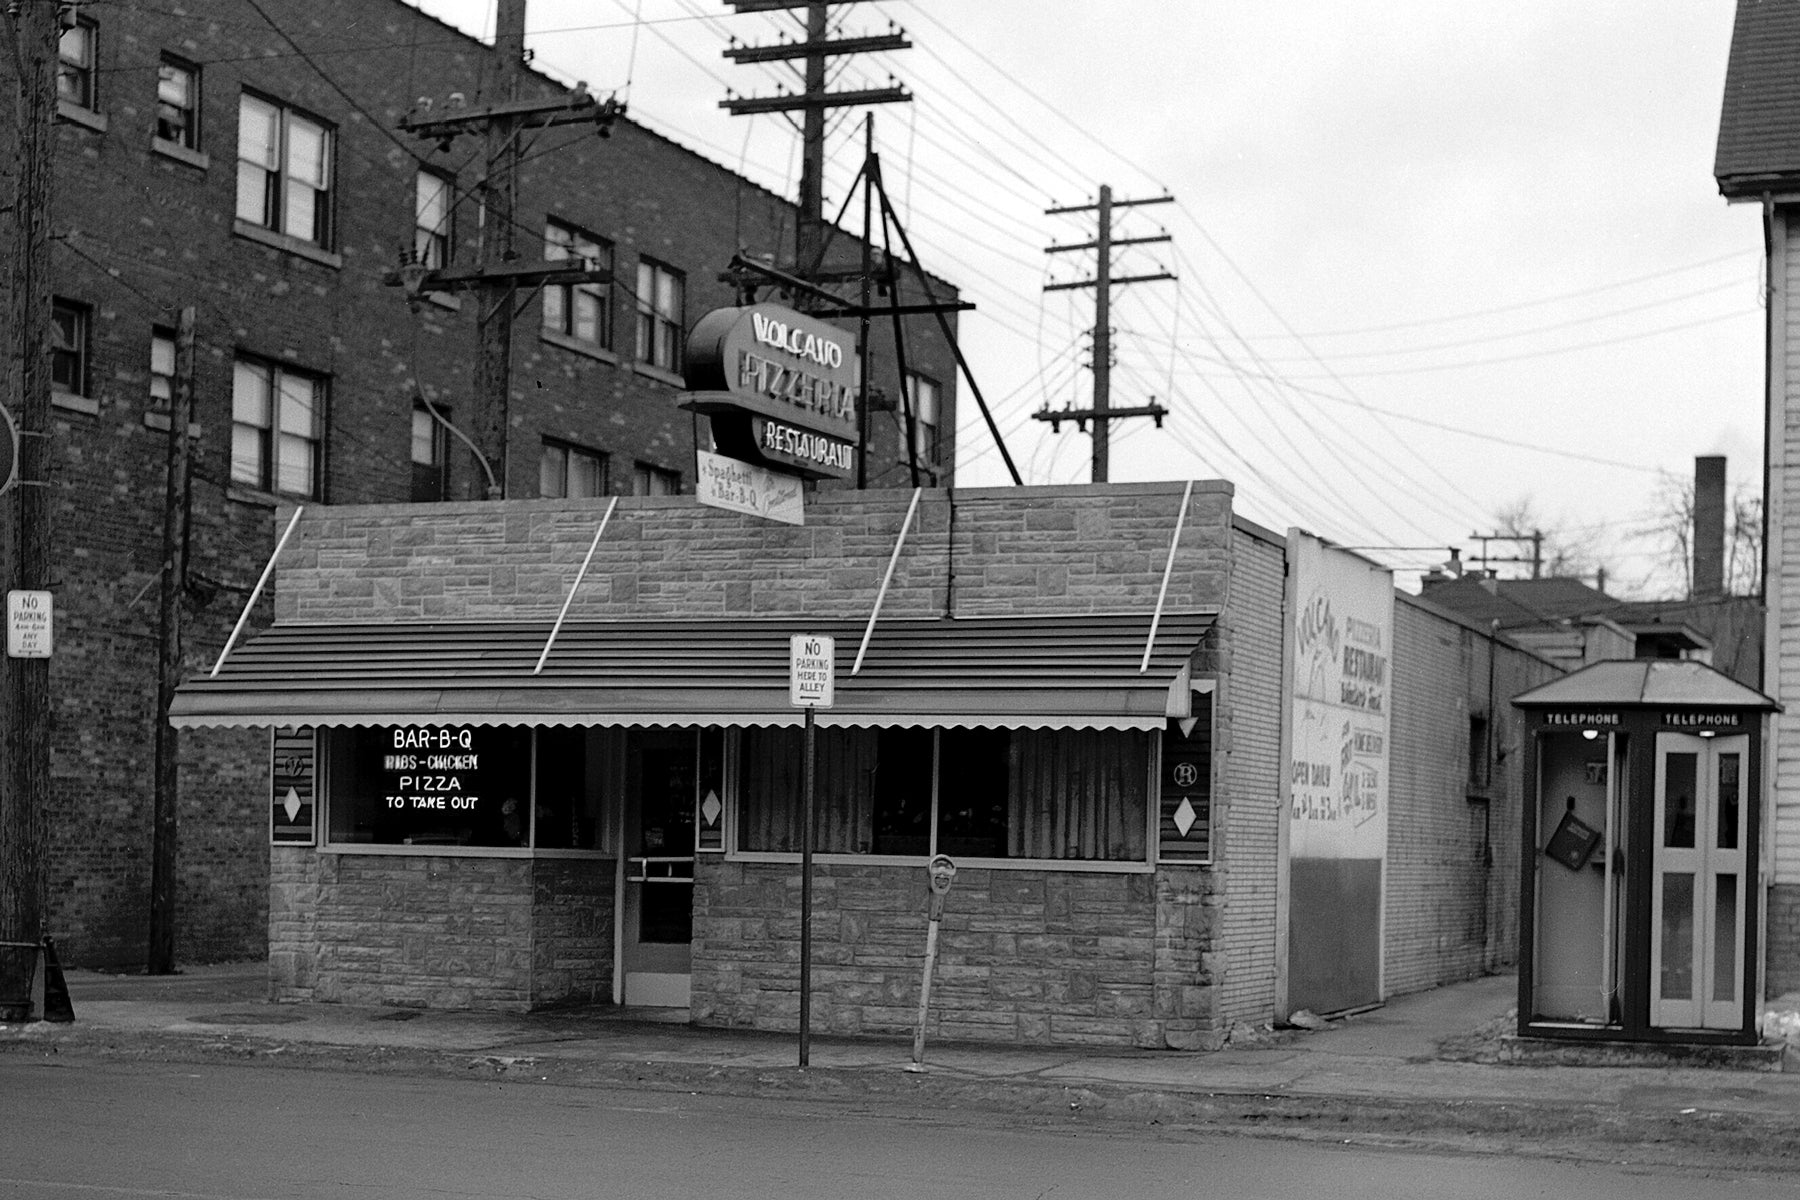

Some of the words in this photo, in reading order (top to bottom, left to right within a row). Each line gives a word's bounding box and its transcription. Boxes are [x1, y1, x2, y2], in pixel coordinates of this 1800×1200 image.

[753, 312, 842, 368] VOLCANO
[740, 352, 856, 422] PIZZERIA
[766, 421, 853, 470] RESTAURANT
[707, 458, 752, 490] Spaghetti
[22, 594, 38, 609] NO
[13, 611, 47, 622] PARKING
[804, 642, 820, 656] NO
[795, 657, 829, 670] PARKING
[797, 671, 817, 681] HERE
[818, 672, 827, 681] TO
[799, 682, 825, 692] ALLEY
[1547, 713, 1619, 725] TELEPHONE
[1665, 714, 1739, 726] TELEPHONE
[394, 729, 472, 750] BAR-B-Q
[399, 776, 461, 791] PIZZA
[386, 796, 404, 809] TO
[409, 797, 446, 809] TAKE
[451, 797, 479, 809] OUT
